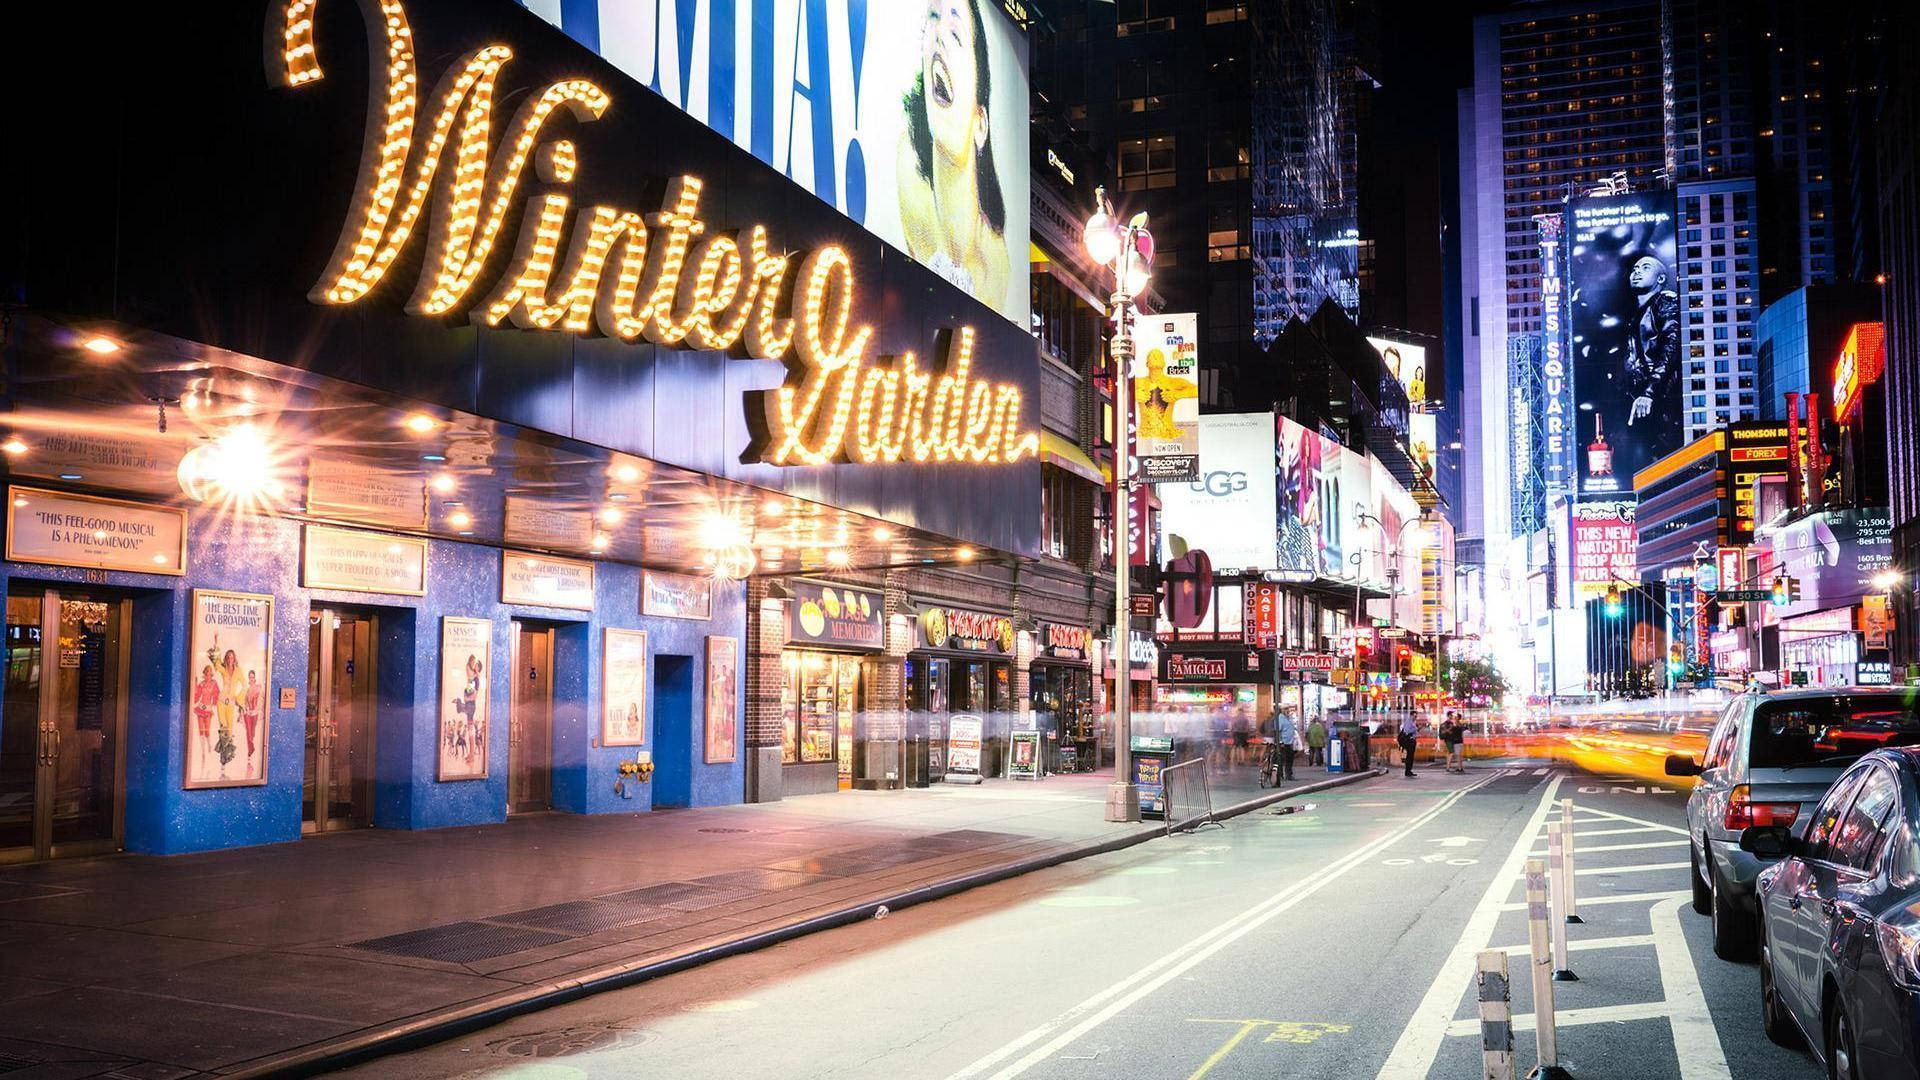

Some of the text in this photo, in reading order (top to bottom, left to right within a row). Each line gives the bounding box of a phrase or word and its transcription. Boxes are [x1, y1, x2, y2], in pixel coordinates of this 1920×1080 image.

[277, 0, 797, 360] Winter
[1541, 241, 1564, 453] TIMES SQUARE
[772, 244, 1041, 467] Garden
[1167, 366, 1190, 375] Brick
[1732, 428, 1777, 440] THOMSON
[1167, 444, 1181, 452] OPEN
[1746, 449, 1777, 459] FOREX
[1144, 458, 1190, 468] Discovery
[65, 514, 116, 532] FEEL-GOOD
[118, 522, 156, 537] MUSICAL
[52, 529, 61, 542] IS
[64, 531, 71, 542] A
[1576, 526, 1632, 540] THIS NEW
[1576, 540, 1617, 554] WATCH
[1577, 554, 1608, 567] DROP
[1857, 563, 1871, 571] Call
[1577, 567, 1609, 580] YOUR
[1247, 582, 1256, 615] FOOT
[1727, 591, 1765, 600] W 50 St
[223, 603, 240, 615] BEST
[243, 605, 259, 616] TIME
[1260, 588, 1271, 629] OASIS
[205, 614, 216, 624] ON
[831, 621, 876, 641] MEMORIES
[1285, 657, 1331, 668] FAMIGLIA
